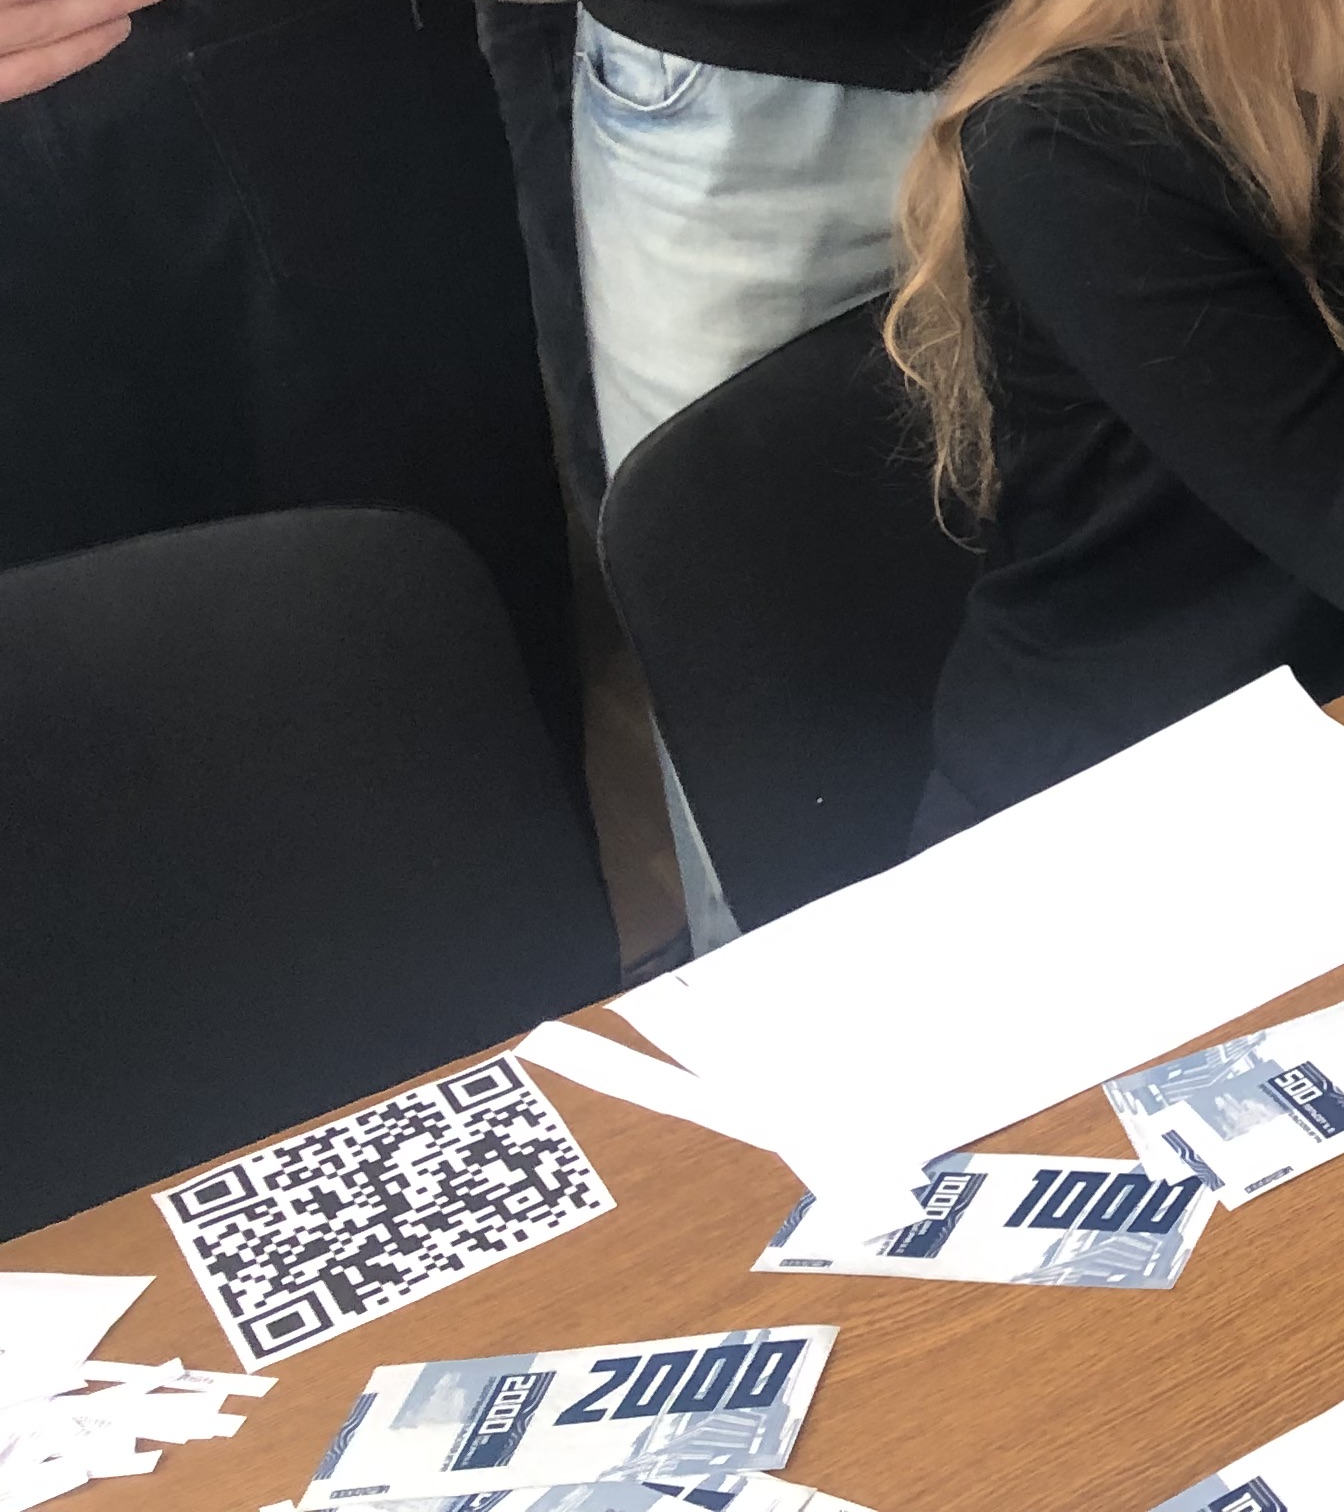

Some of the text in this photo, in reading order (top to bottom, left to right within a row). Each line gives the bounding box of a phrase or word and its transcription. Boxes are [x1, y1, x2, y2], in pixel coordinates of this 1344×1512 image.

[1274, 1068, 1323, 1105] 500
[1003, 1169, 1203, 1234] 1000
[478, 1375, 537, 1434] 2000
[553, 1339, 808, 1426] 2000
